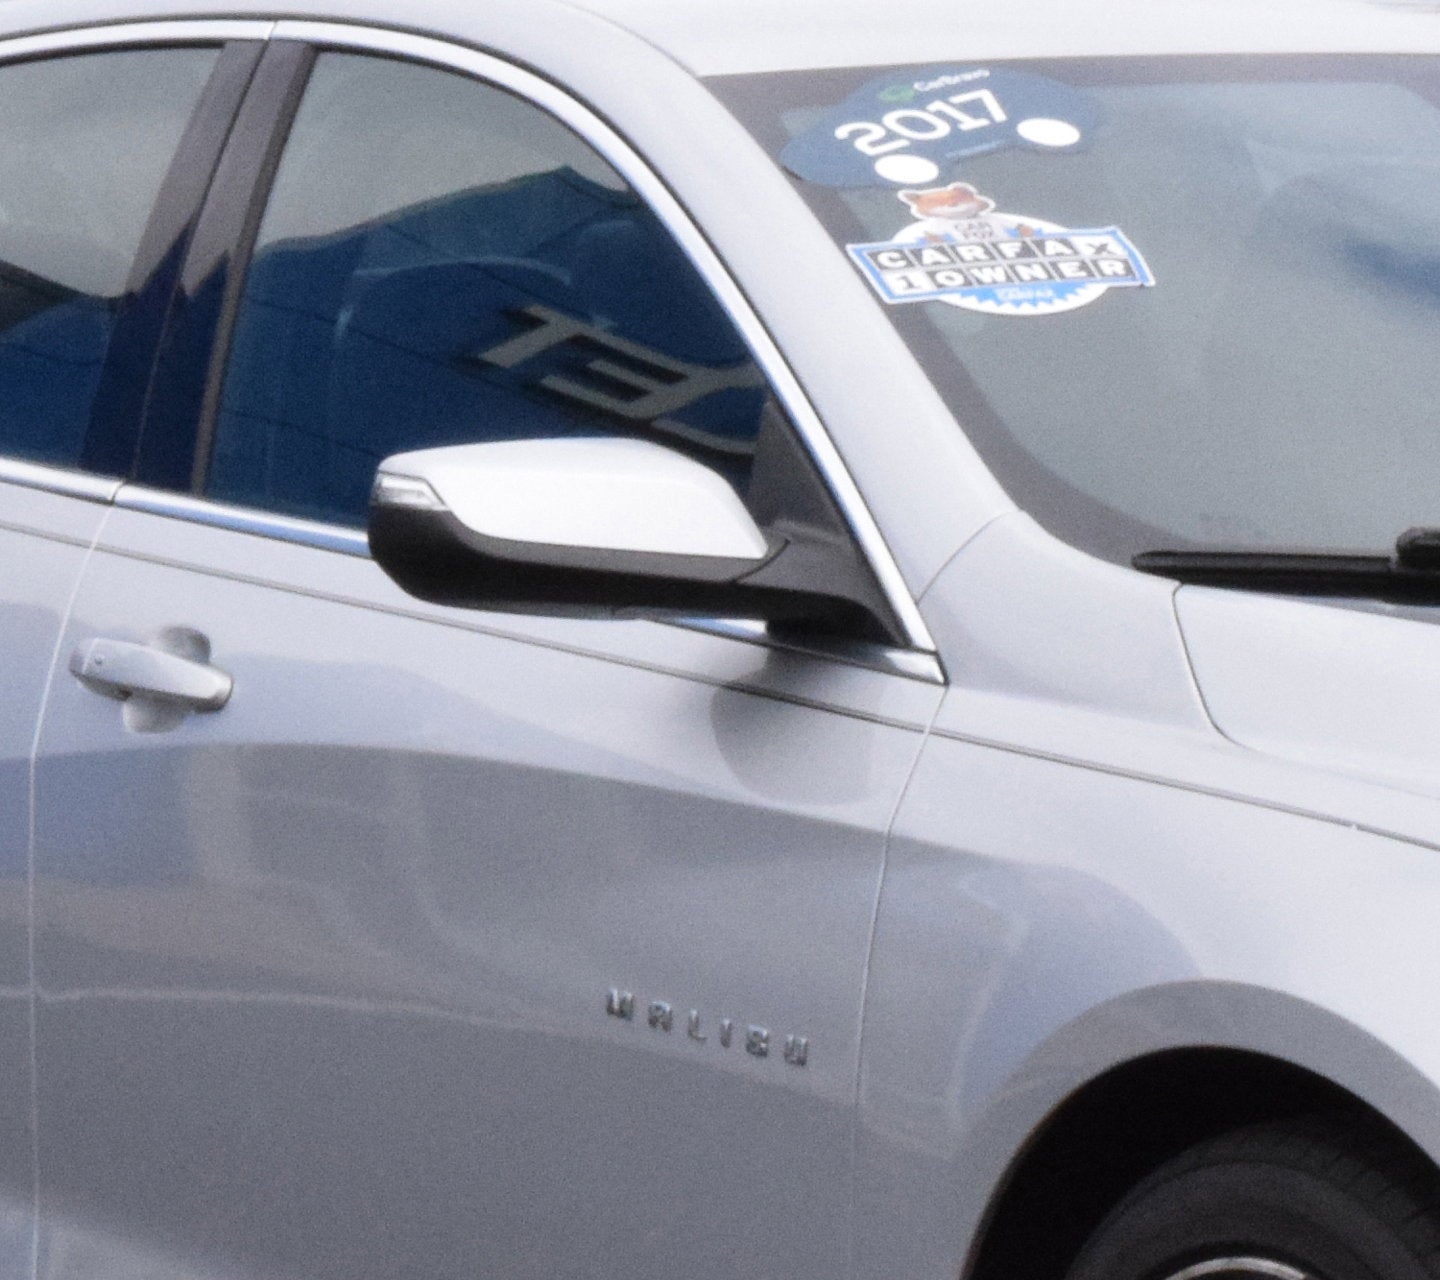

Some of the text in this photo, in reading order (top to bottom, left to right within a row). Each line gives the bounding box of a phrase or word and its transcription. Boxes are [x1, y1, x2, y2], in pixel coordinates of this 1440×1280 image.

[833, 88, 1008, 157] 2017
[876, 237, 1119, 269] CARFAX
[606, 987, 810, 1068] MALIBU
